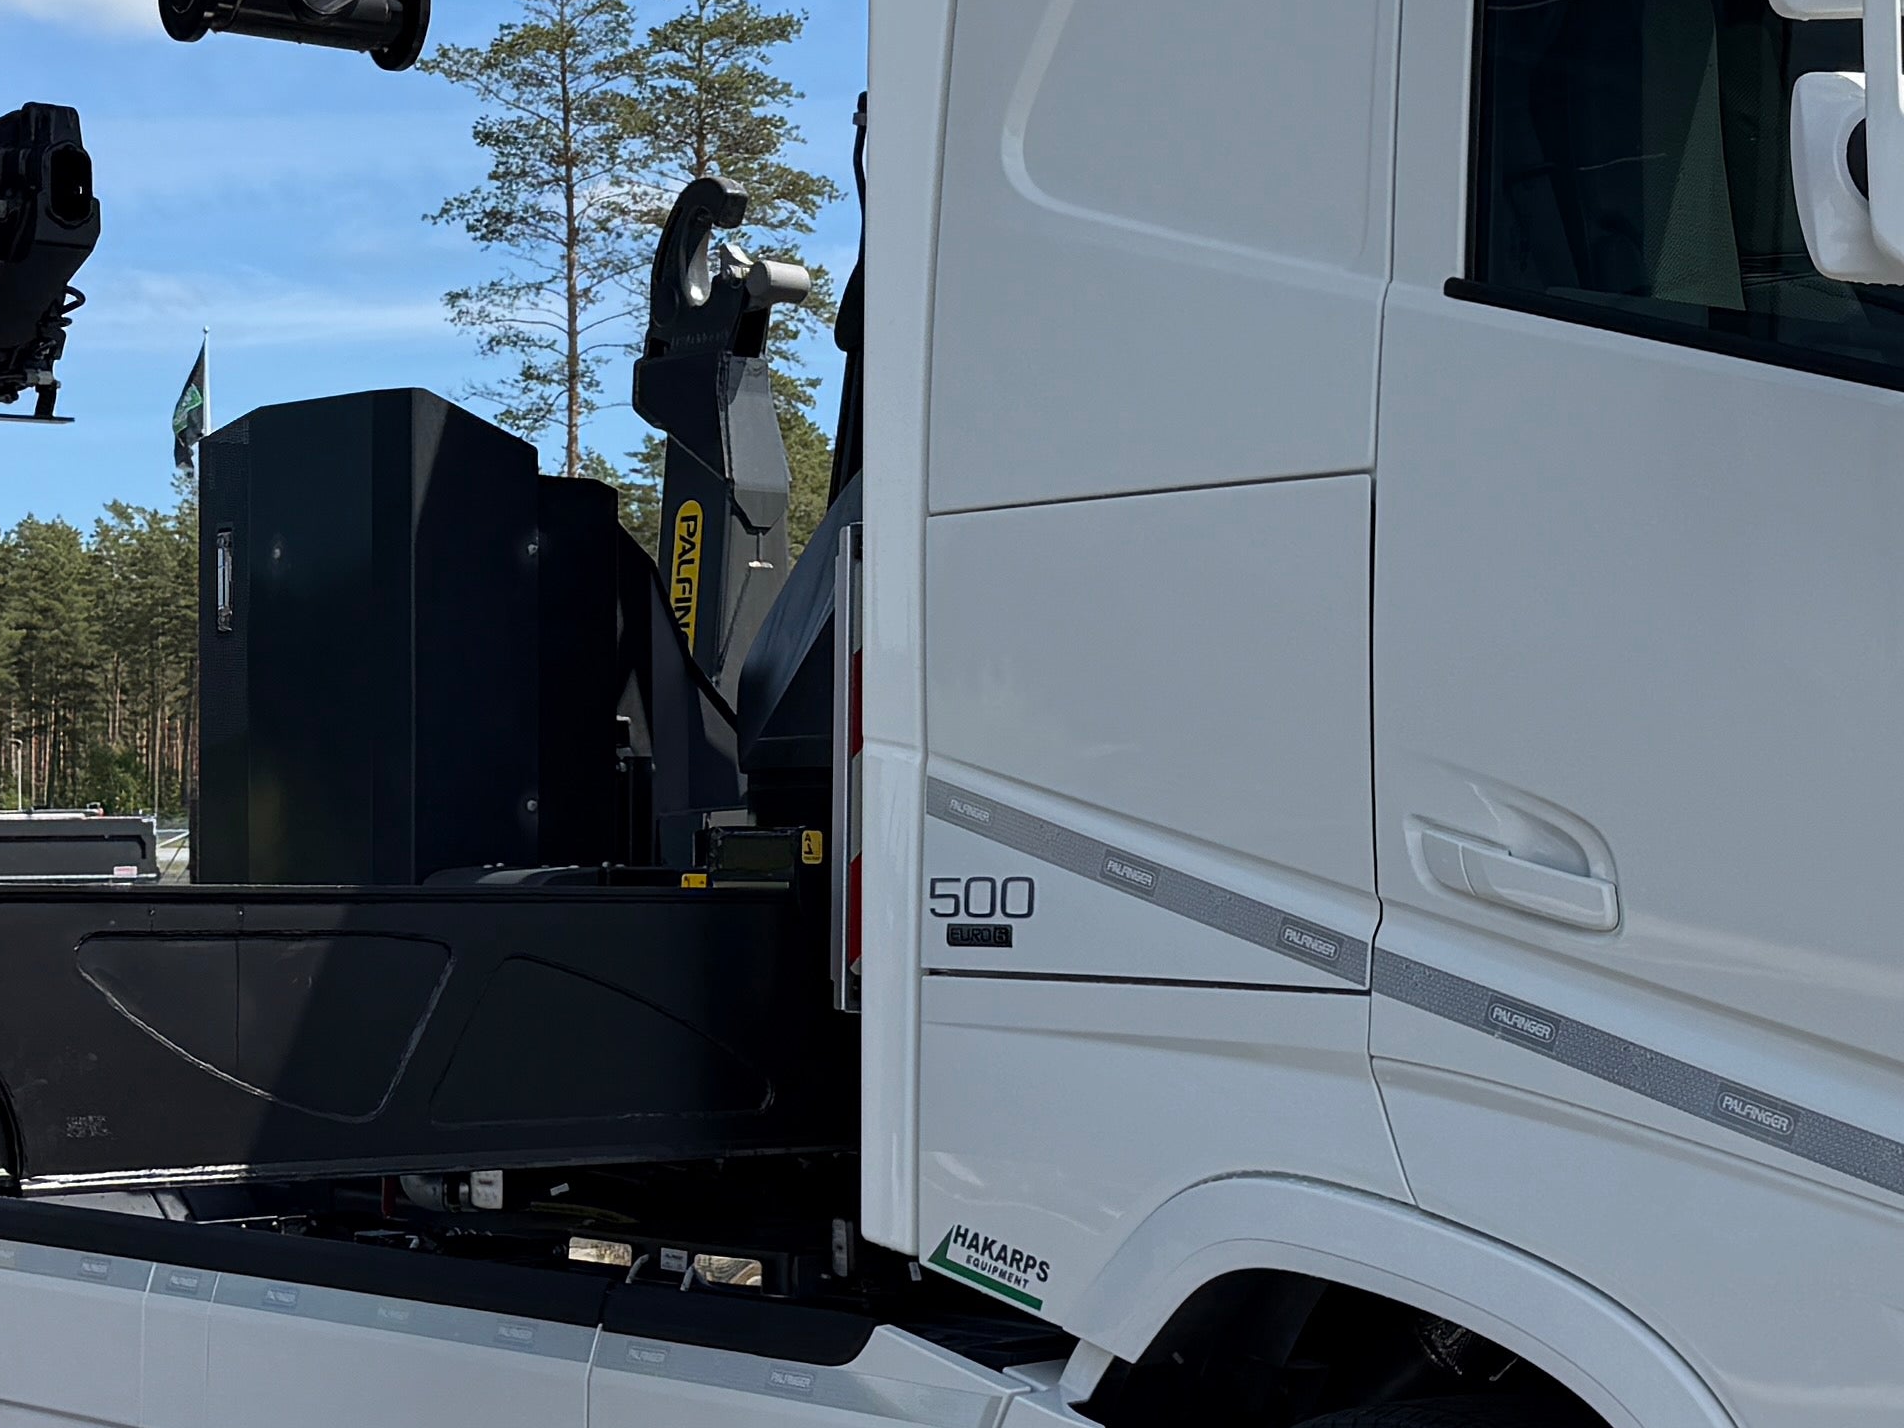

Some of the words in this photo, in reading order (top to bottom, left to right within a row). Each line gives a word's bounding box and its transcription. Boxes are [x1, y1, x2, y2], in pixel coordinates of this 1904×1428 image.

[948, 798, 991, 823] PALFINGER
[1106, 859, 1154, 887] PALFINGER
[929, 875, 1036, 919] 500
[950, 927, 992, 943] EURO
[1283, 926, 1336, 959] PALFINGER
[1492, 1004, 1553, 1040] PALFINGER
[1721, 1094, 1791, 1134] PALFINGER
[952, 1223, 1051, 1283] HAKARPS
[965, 1254, 1030, 1290] EQUIPMENT
